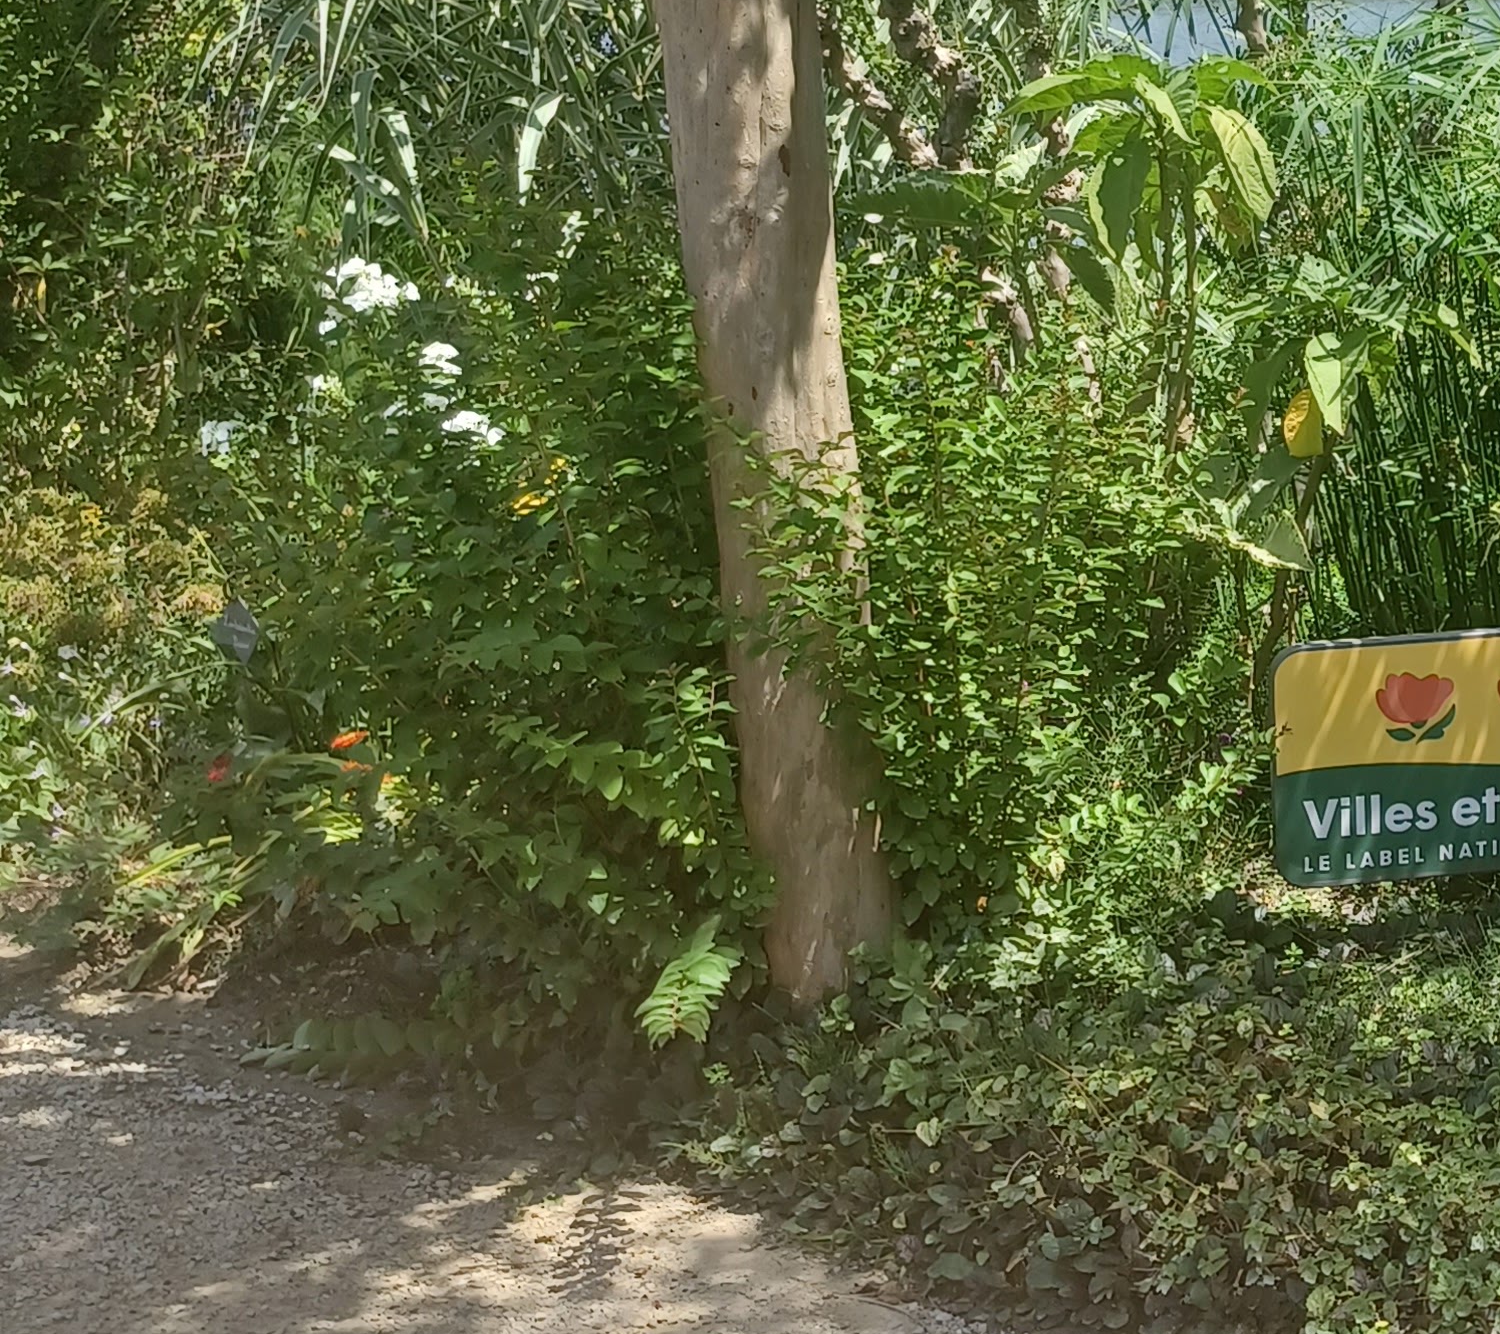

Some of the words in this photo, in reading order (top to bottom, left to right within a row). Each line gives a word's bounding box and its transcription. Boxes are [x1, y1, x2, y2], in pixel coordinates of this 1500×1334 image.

[1303, 793, 1438, 839] Villes
[1451, 786, 1500, 827] et
[1304, 855, 1330, 873] LE
[1346, 846, 1425, 870] LABEL
